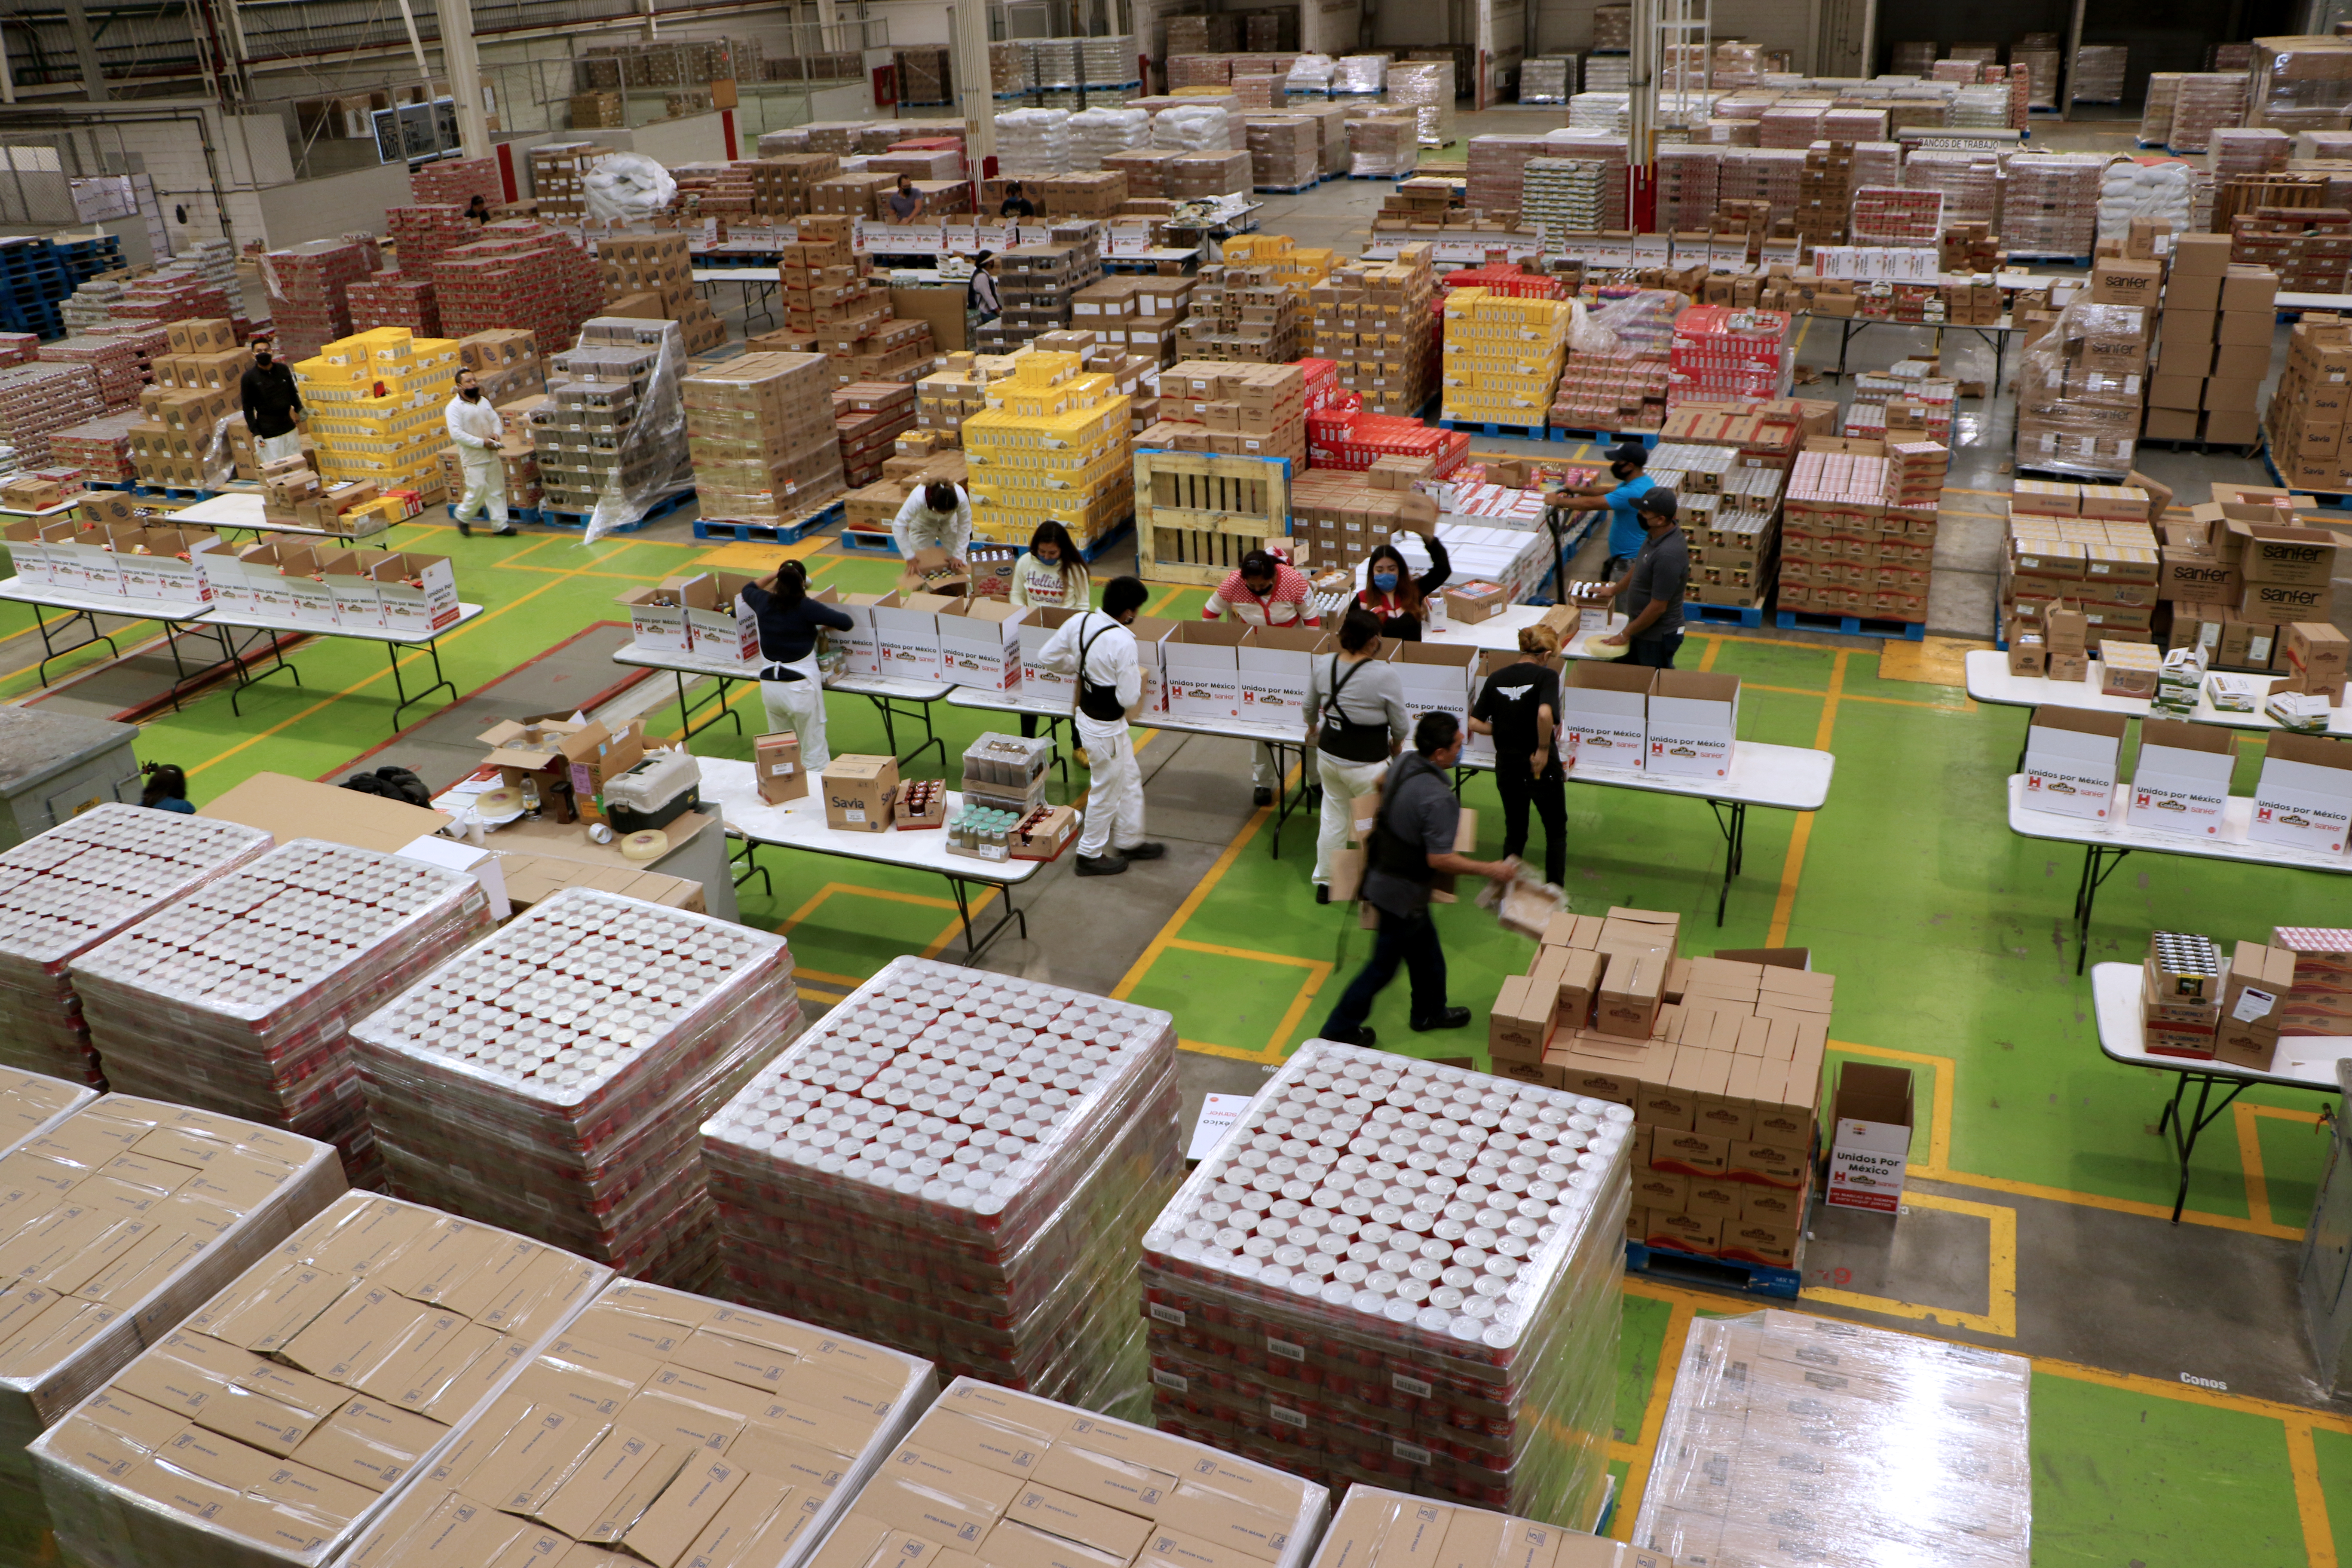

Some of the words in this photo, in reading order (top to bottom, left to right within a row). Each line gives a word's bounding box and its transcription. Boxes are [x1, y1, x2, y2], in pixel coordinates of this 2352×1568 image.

[1919, 139, 1949, 147] BANCOS
[1964, 140, 1998, 149] TRABAJO
[2106, 276, 2150, 288] sanfer
[2092, 341, 2138, 354] sanfer
[2315, 400, 2338, 408] Savia
[2308, 434, 2330, 442] Savia
[2303, 466, 2324, 475] Savia
[2263, 545, 2323, 561] sanfer
[1026, 570, 1063, 588] Holliste
[2174, 566, 2232, 582] sanfer
[428, 588, 444, 598] Unidos
[434, 591, 450, 602] México
[1029, 594, 1063, 603] CALIFORNI
[2260, 588, 2321, 604] sanfer
[883, 648, 891, 657] H
[1009, 645, 1020, 657] Méxic
[945, 655, 953, 664] H
[1026, 668, 1034, 677] H
[1172, 686, 1182, 695] H
[1244, 691, 1254, 701] H
[1570, 732, 1580, 742] H
[1652, 743, 1663, 753] H
[2028, 769, 2057, 778] Unidos
[2079, 777, 2109, 786] México
[2029, 776, 2041, 787] H
[882, 785, 897, 805] Savia
[2081, 789, 2105, 798] sanfer
[2138, 787, 2168, 796] Unidos
[2190, 794, 2221, 803] México
[2138, 793, 2150, 805] H
[832, 796, 865, 808] Savia
[2191, 806, 2217, 815] sanfer
[2259, 800, 2291, 811] Unidos
[2314, 810, 2347, 820] México
[2259, 808, 2272, 819] H
[2315, 823, 2340, 831] sanfer
[1838, 1152, 1876, 1163] Unidos
[1880, 1158, 1900, 1167] Por
[1849, 1164, 1889, 1175] México
[2180, 1372, 2227, 1390] Conos
[1021, 1450, 1027, 1459] 5
[688, 1494, 701, 1507] ESTIBA
[924, 1514, 940, 1523] ESTIBA
[968, 1524, 976, 1533] 5
[1231, 1525, 1248, 1534] ESTIBA
